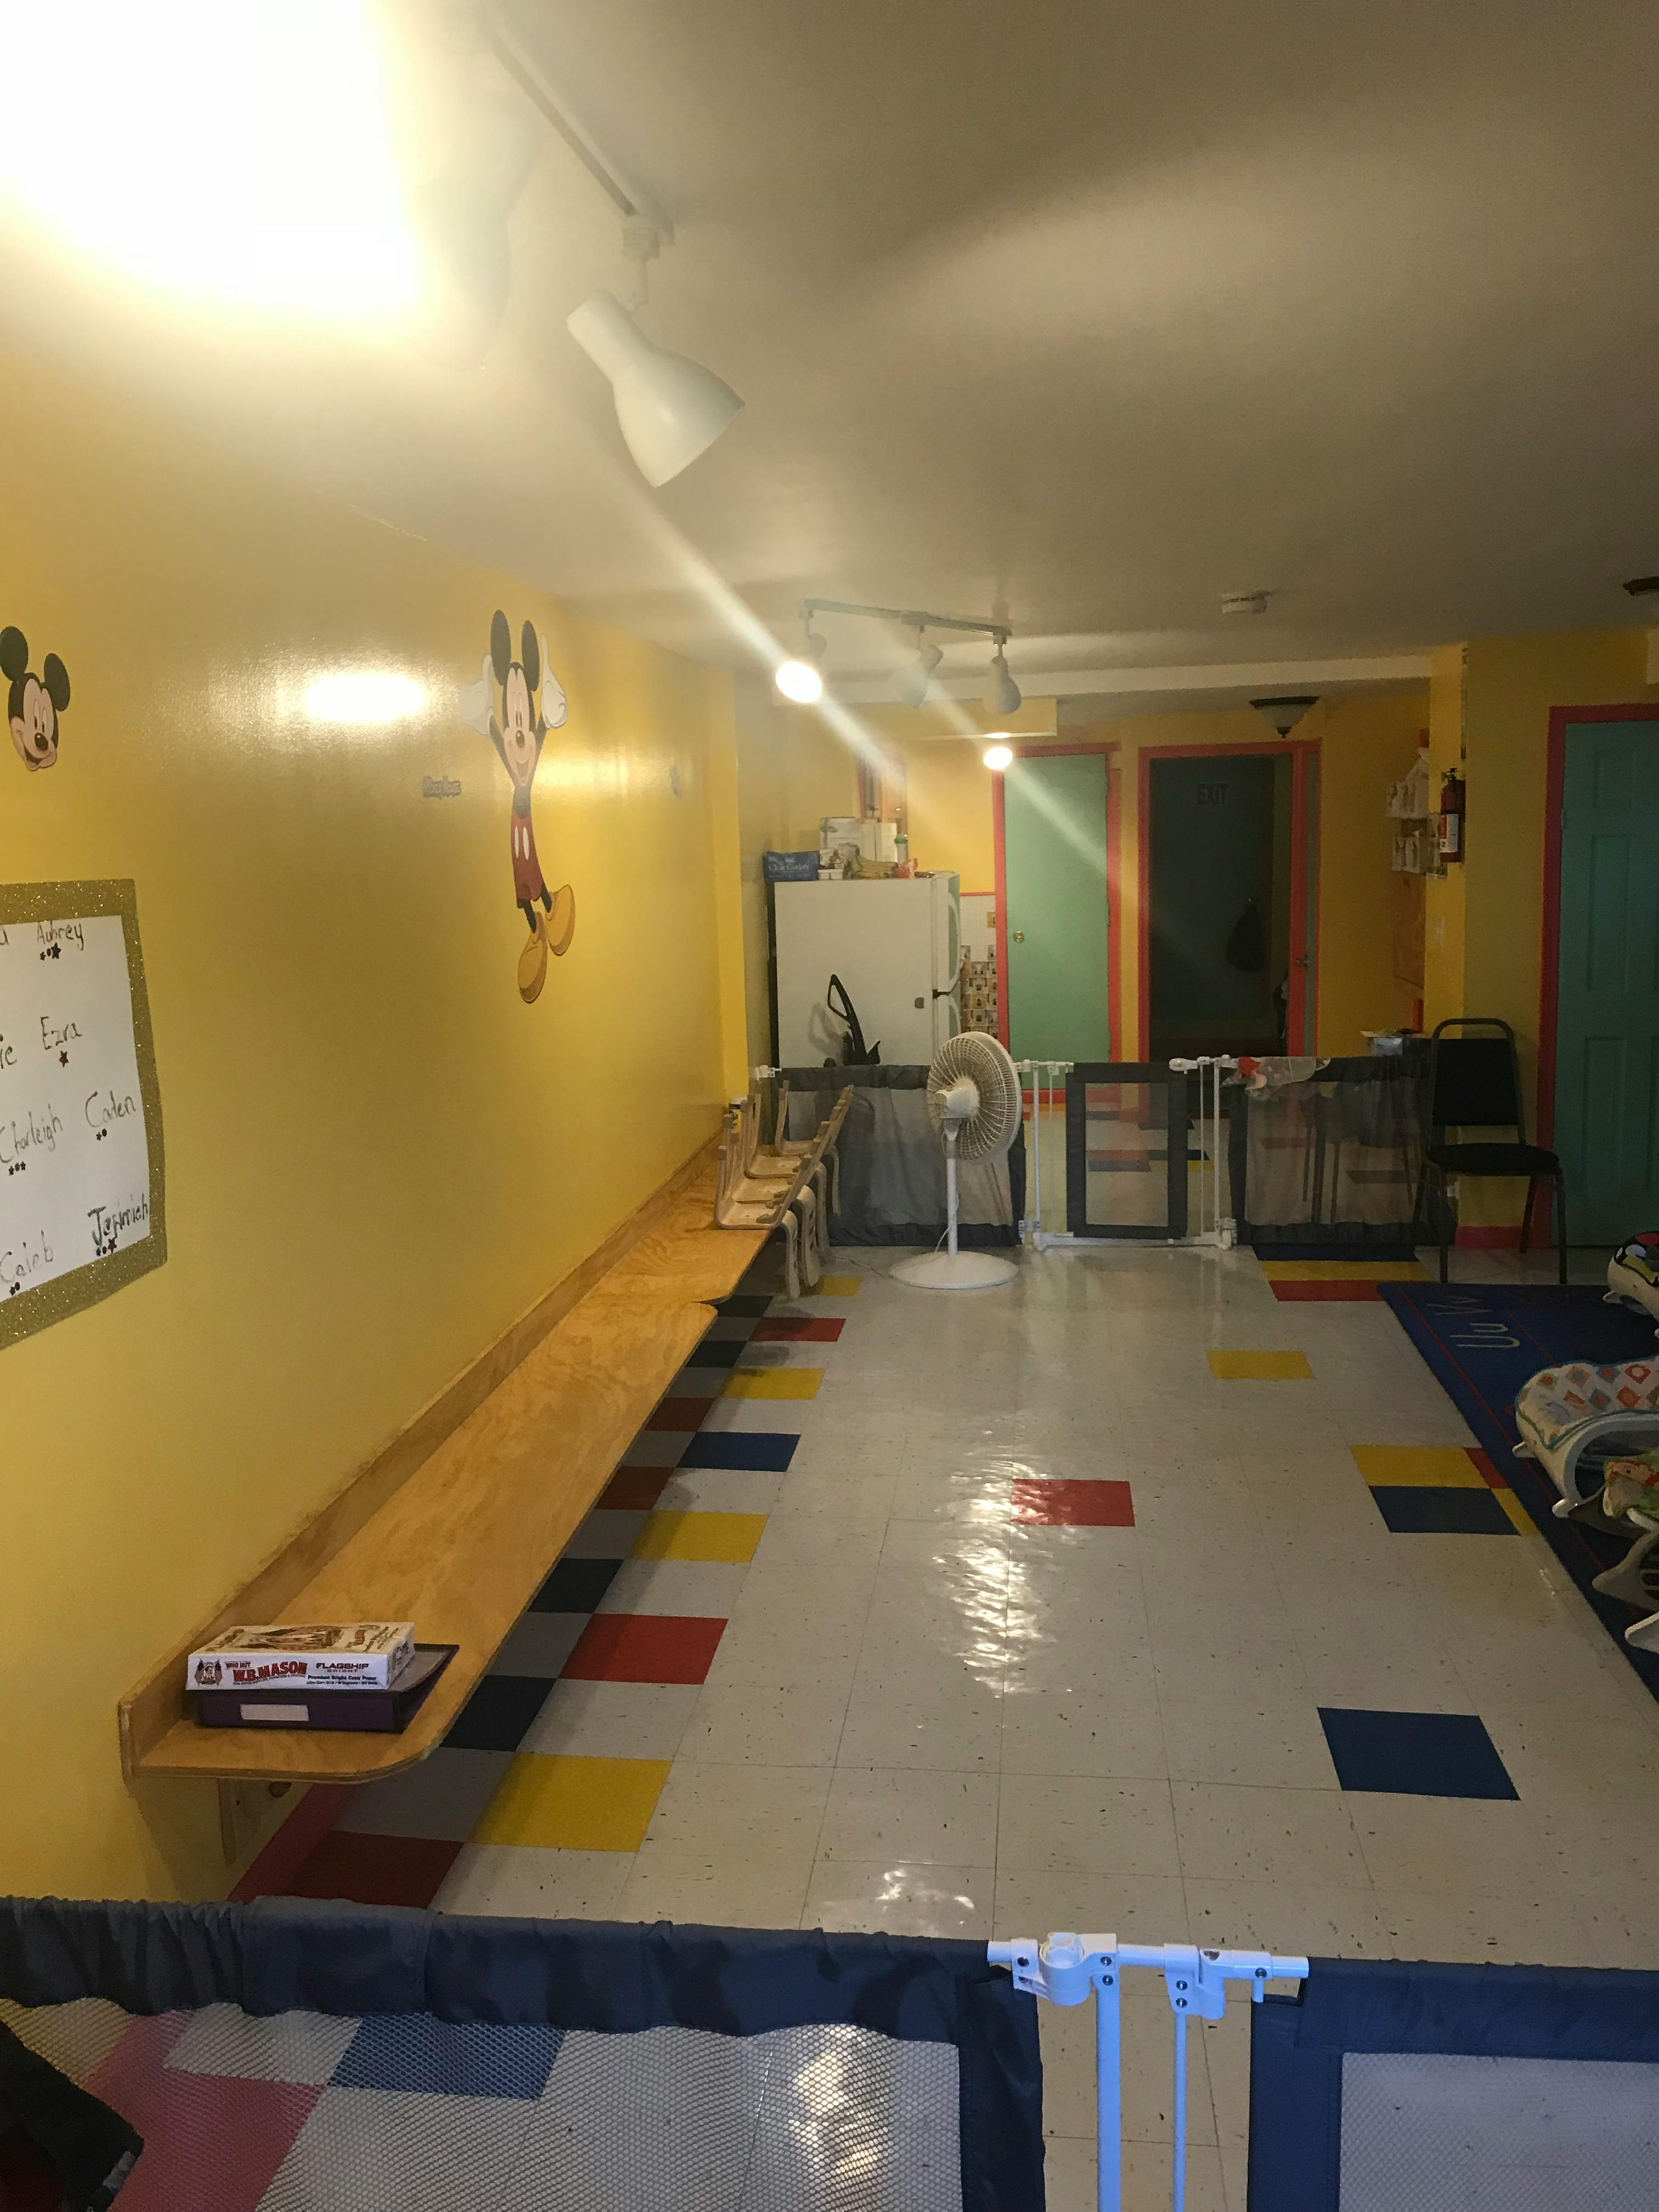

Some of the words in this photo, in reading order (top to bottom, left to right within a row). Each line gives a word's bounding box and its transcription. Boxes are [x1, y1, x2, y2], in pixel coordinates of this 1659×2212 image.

[1198, 783, 1229, 805] EXIT
[37, 921, 84, 951] Aubrey
[41, 1016, 82, 1050] Ezra
[86, 1091, 136, 1127] Caden
[0, 1229, 54, 1283] Caleb
